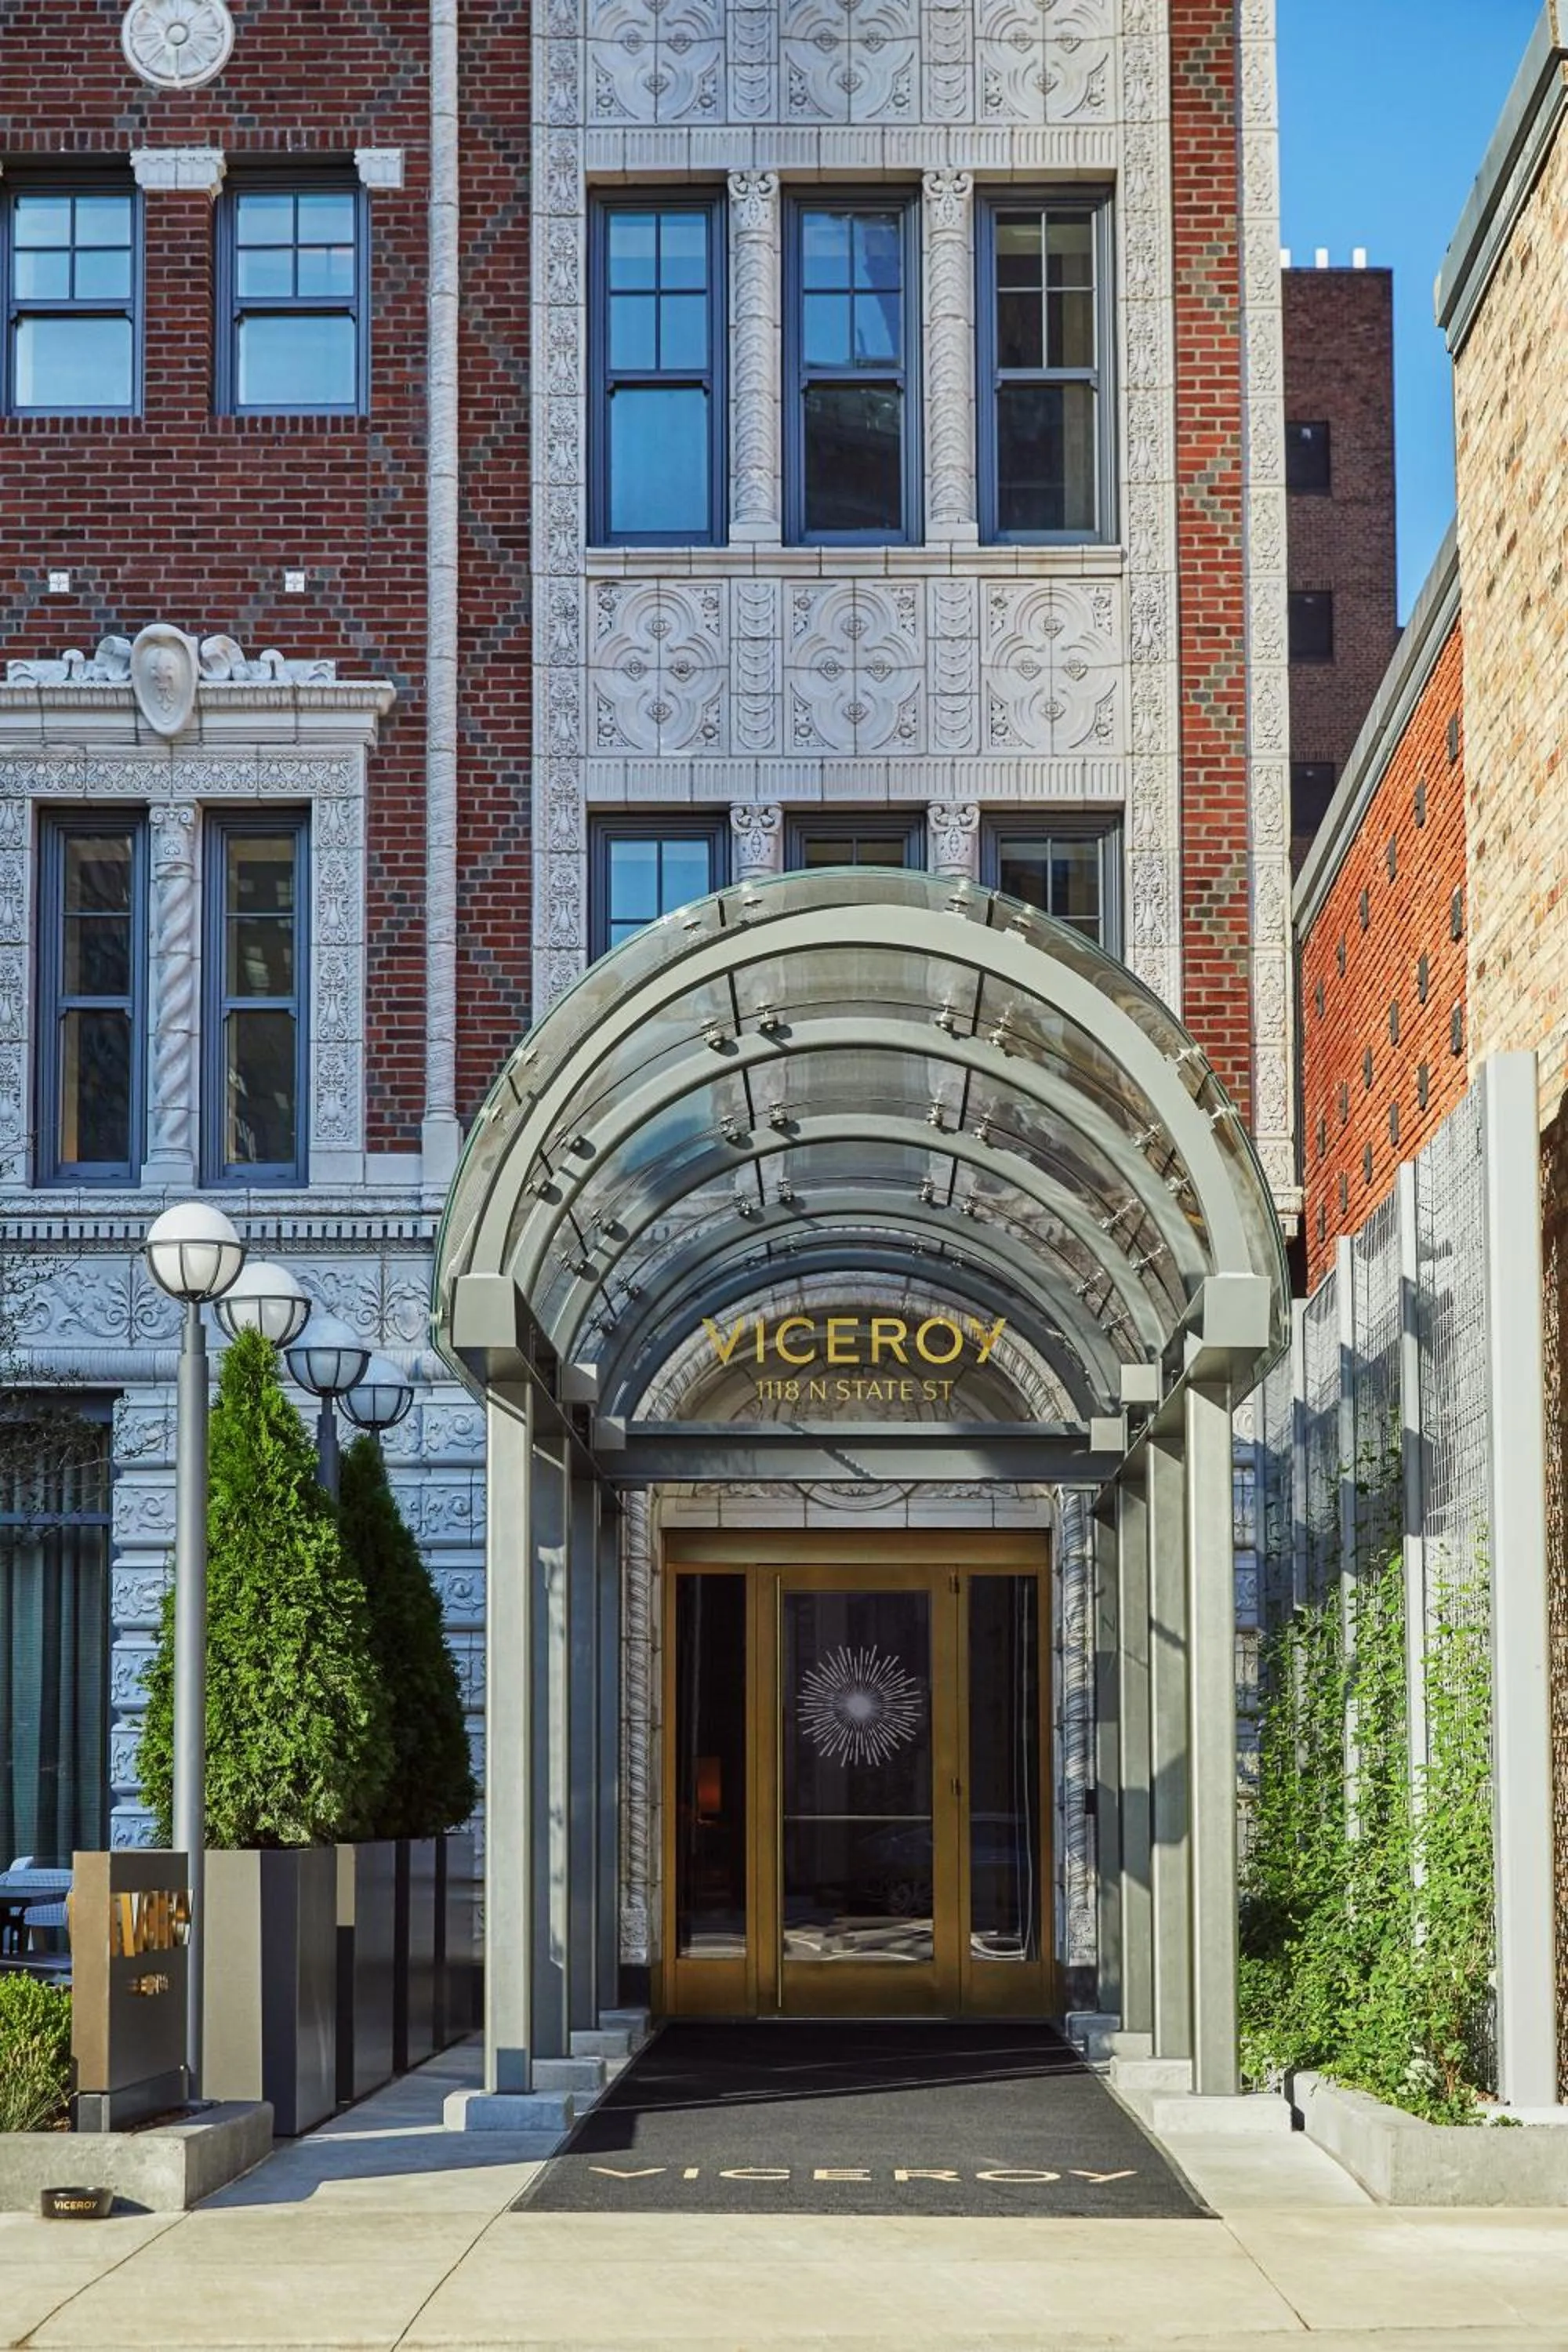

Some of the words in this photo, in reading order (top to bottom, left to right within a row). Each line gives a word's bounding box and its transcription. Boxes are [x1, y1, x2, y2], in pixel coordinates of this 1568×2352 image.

[702, 1316, 1006, 1365] VICEROY
[756, 1380, 798, 1400] 1118
[808, 1380, 826, 1400] N
[836, 1380, 913, 1401] STATE
[922, 1380, 954, 1401] ST
[588, 2166, 1138, 2182] VICEROY
[54, 2200, 97, 2210] VICEROY
